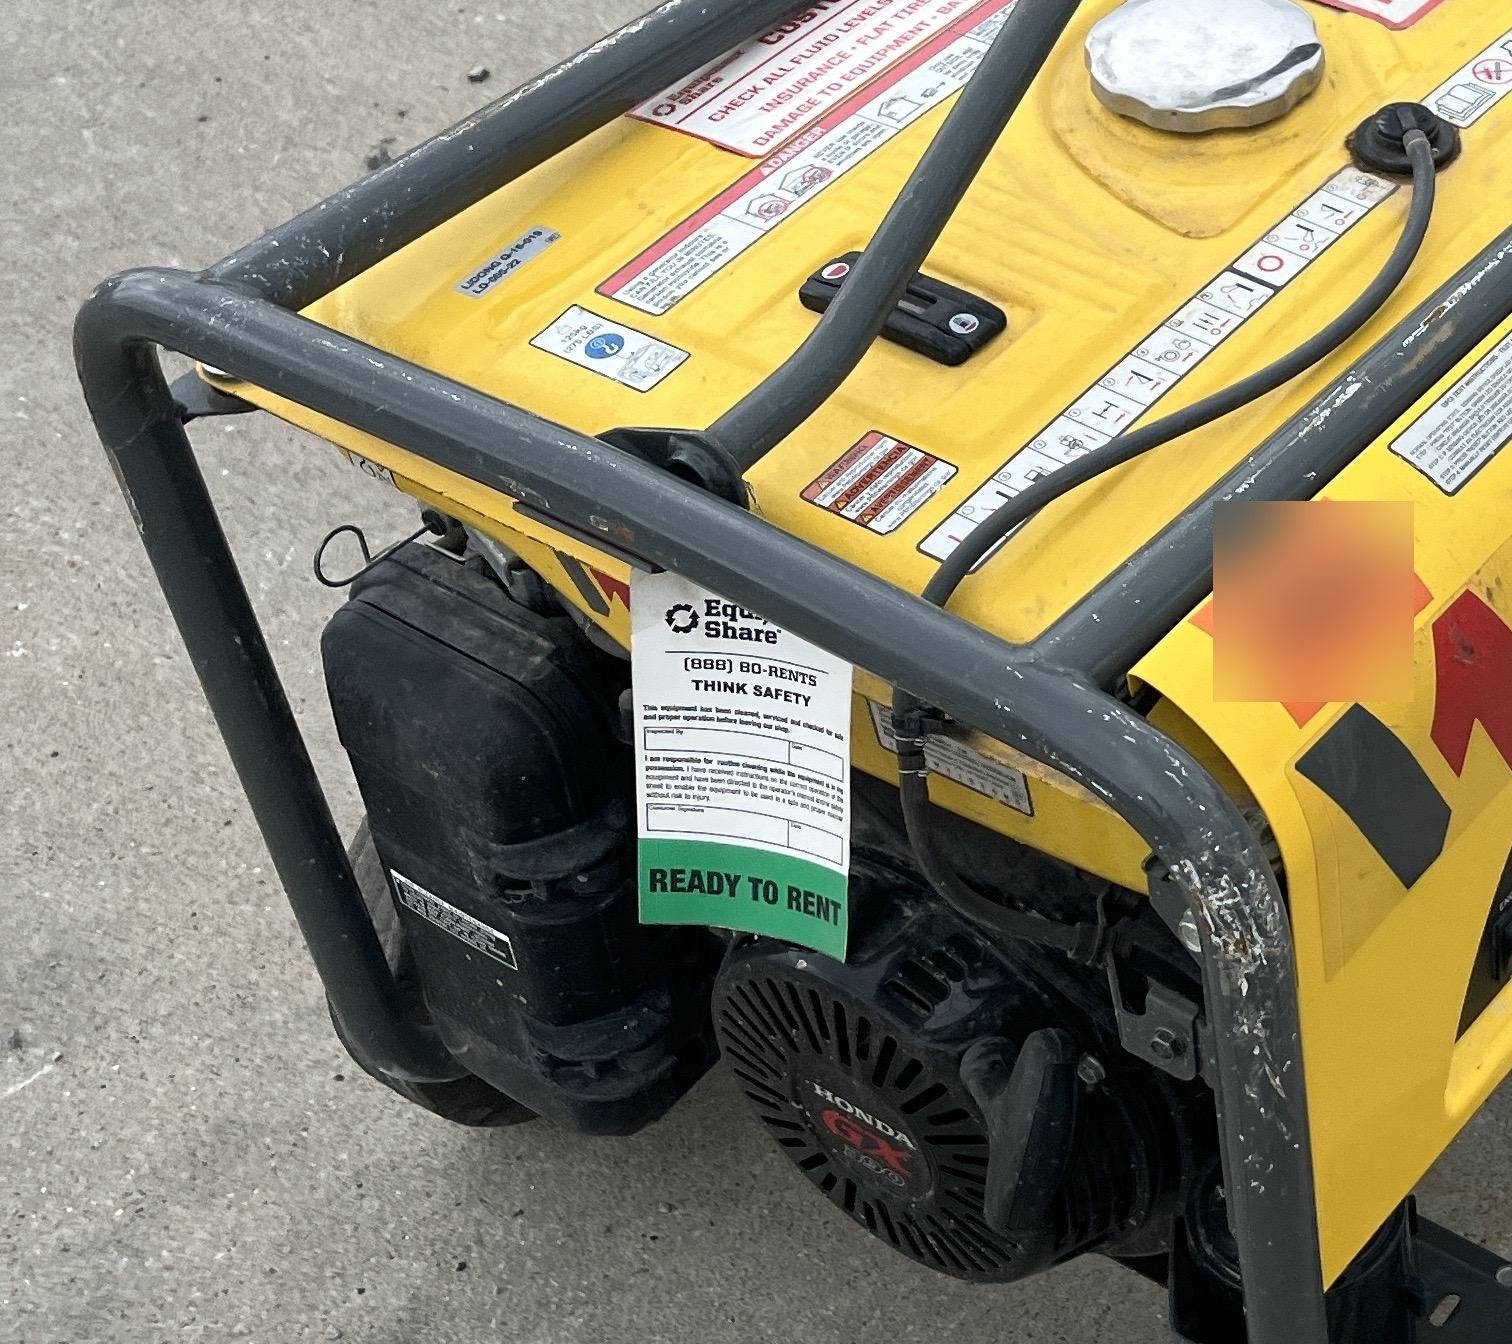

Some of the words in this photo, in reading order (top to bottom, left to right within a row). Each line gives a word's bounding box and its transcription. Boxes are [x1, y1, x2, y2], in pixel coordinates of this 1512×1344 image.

[707, 85, 766, 123] CHECK
[761, 66, 795, 87] ALL
[791, 33, 840, 66] FLUID
[752, 96, 824, 148] DAMAGE
[815, 82, 844, 98] TO
[839, 19, 932, 82] EQUIPMENT
[757, 50, 852, 114] INSURANCE
[855, 19, 891, 47] FLAT
[704, 620, 778, 645] Share
[683, 657, 733, 675] (888)
[739, 660, 818, 688] 80-RENTS
[691, 679, 748, 695] THINK
[752, 684, 812, 708] SAFETY
[649, 868, 742, 899] READY
[747, 875, 780, 906] TO
[786, 884, 843, 927] RENT
[812, 1082, 918, 1152] HONDA
[821, 1108, 914, 1183] GX
